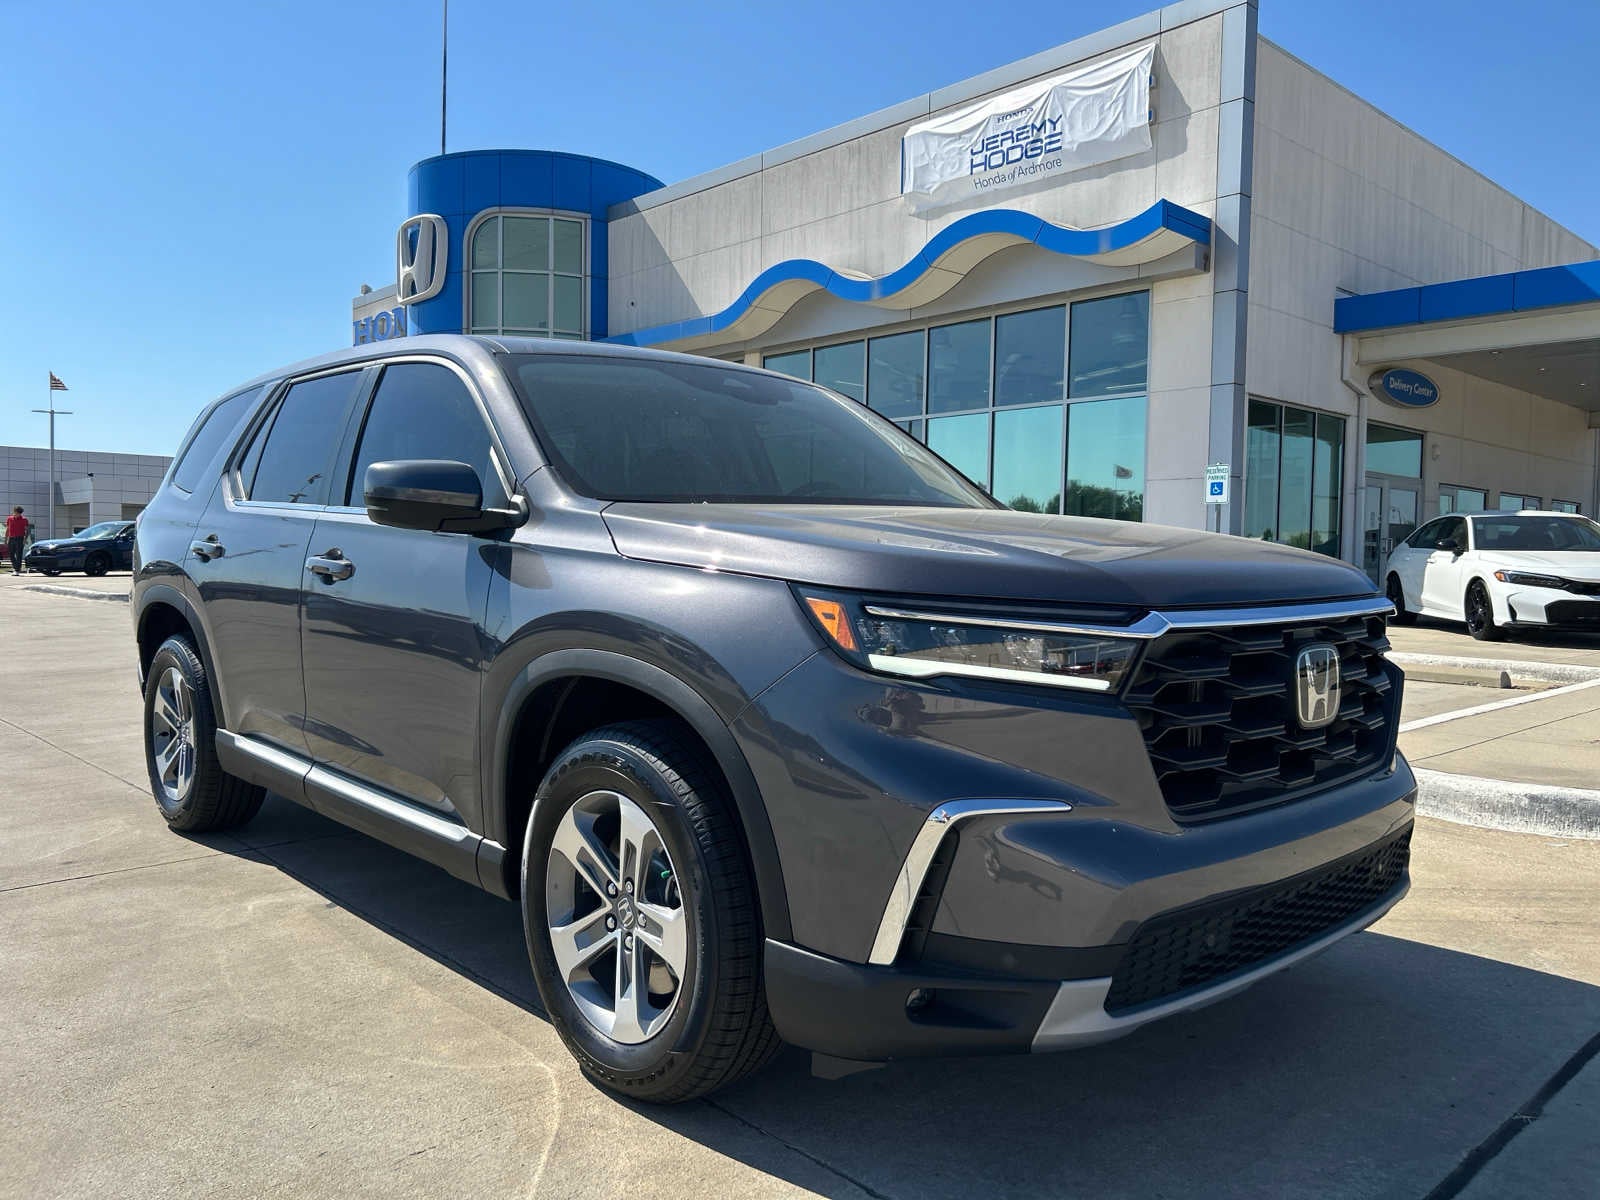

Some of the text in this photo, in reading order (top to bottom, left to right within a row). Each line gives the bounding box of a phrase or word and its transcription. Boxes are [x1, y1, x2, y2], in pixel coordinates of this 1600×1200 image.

[997, 107, 1033, 123] HON
[970, 114, 1062, 155] JEREMY
[969, 131, 1062, 175] HODGE
[973, 158, 1062, 189] Honda of Ardmore
[1389, 376, 1432, 397] Delivery Center
